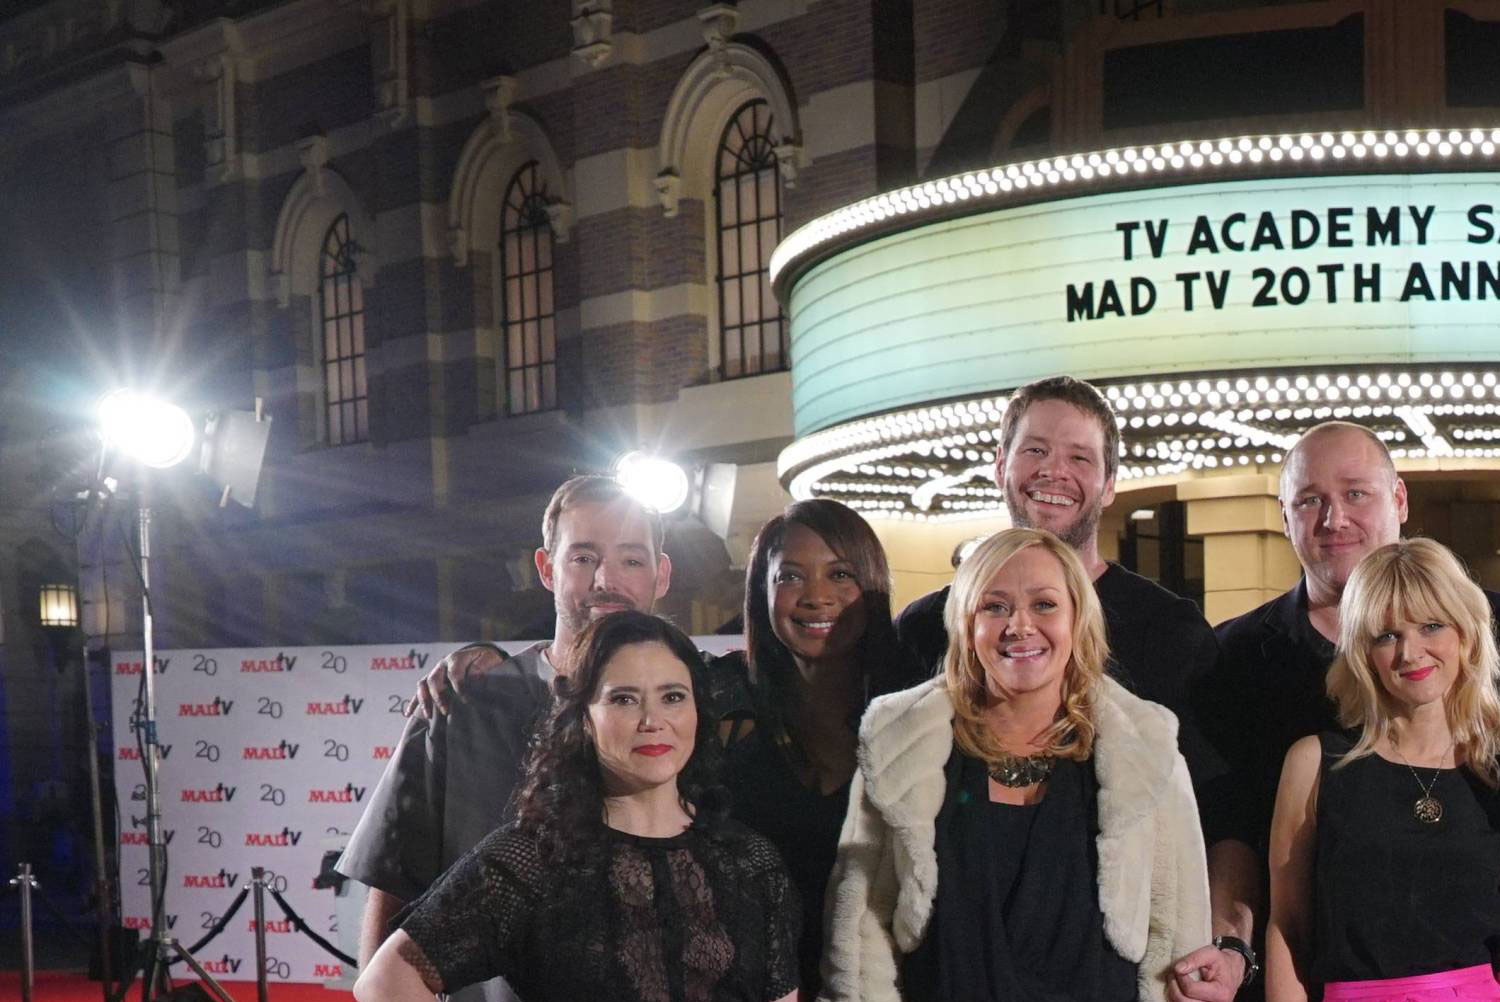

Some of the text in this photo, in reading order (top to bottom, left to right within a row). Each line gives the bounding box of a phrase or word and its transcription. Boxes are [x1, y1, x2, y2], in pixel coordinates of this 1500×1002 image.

[1116, 220, 1169, 261] TV
[1186, 205, 1436, 256] ACADEMY
[1066, 277, 1157, 323] MAD
[1175, 269, 1231, 312] TV
[1252, 263, 1381, 307] 20TH
[193, 654, 217, 676] 20
[321, 651, 346, 674] 20
[258, 697, 283, 719] 20
[195, 740, 219, 762] 20
[324, 739, 349, 761] 20
[260, 784, 285, 806] 20
[198, 826, 222, 848] 20
[265, 957, 290, 979] 20
